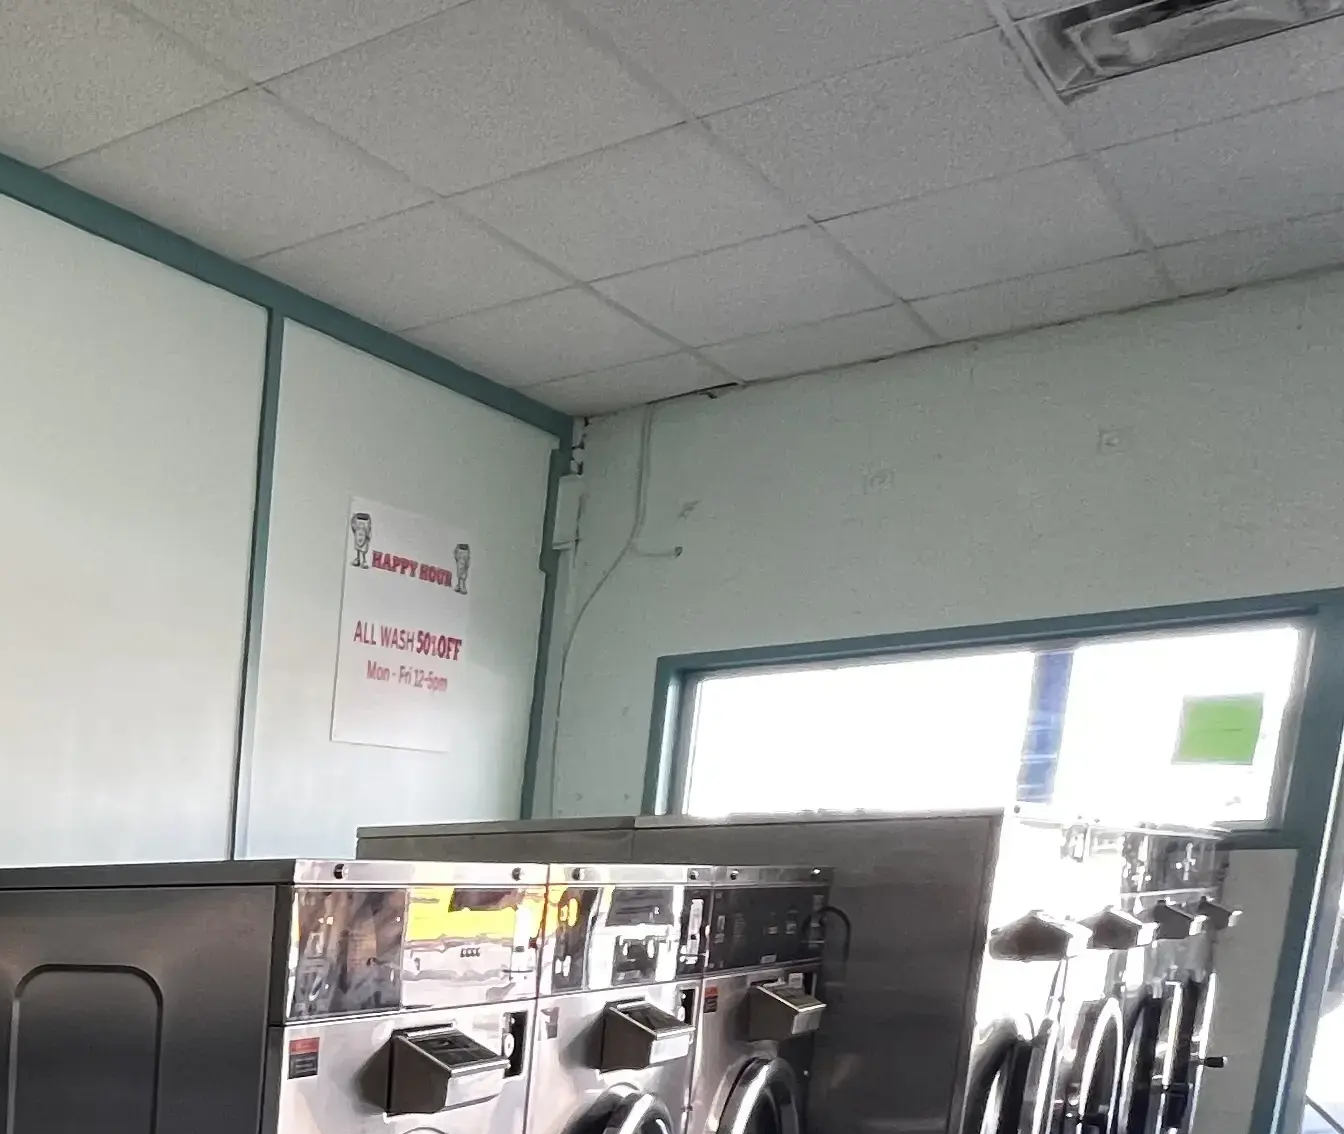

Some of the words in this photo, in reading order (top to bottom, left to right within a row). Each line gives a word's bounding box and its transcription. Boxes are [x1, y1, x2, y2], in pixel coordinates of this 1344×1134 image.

[371, 550, 419, 578] HAPPY
[419, 563, 452, 588] HOUR
[353, 620, 377, 646] ALL
[380, 625, 415, 653] WASH
[366, 660, 390, 682] Mon
[399, 665, 412, 685] Fri
[414, 669, 448, 693] 12-5pm
